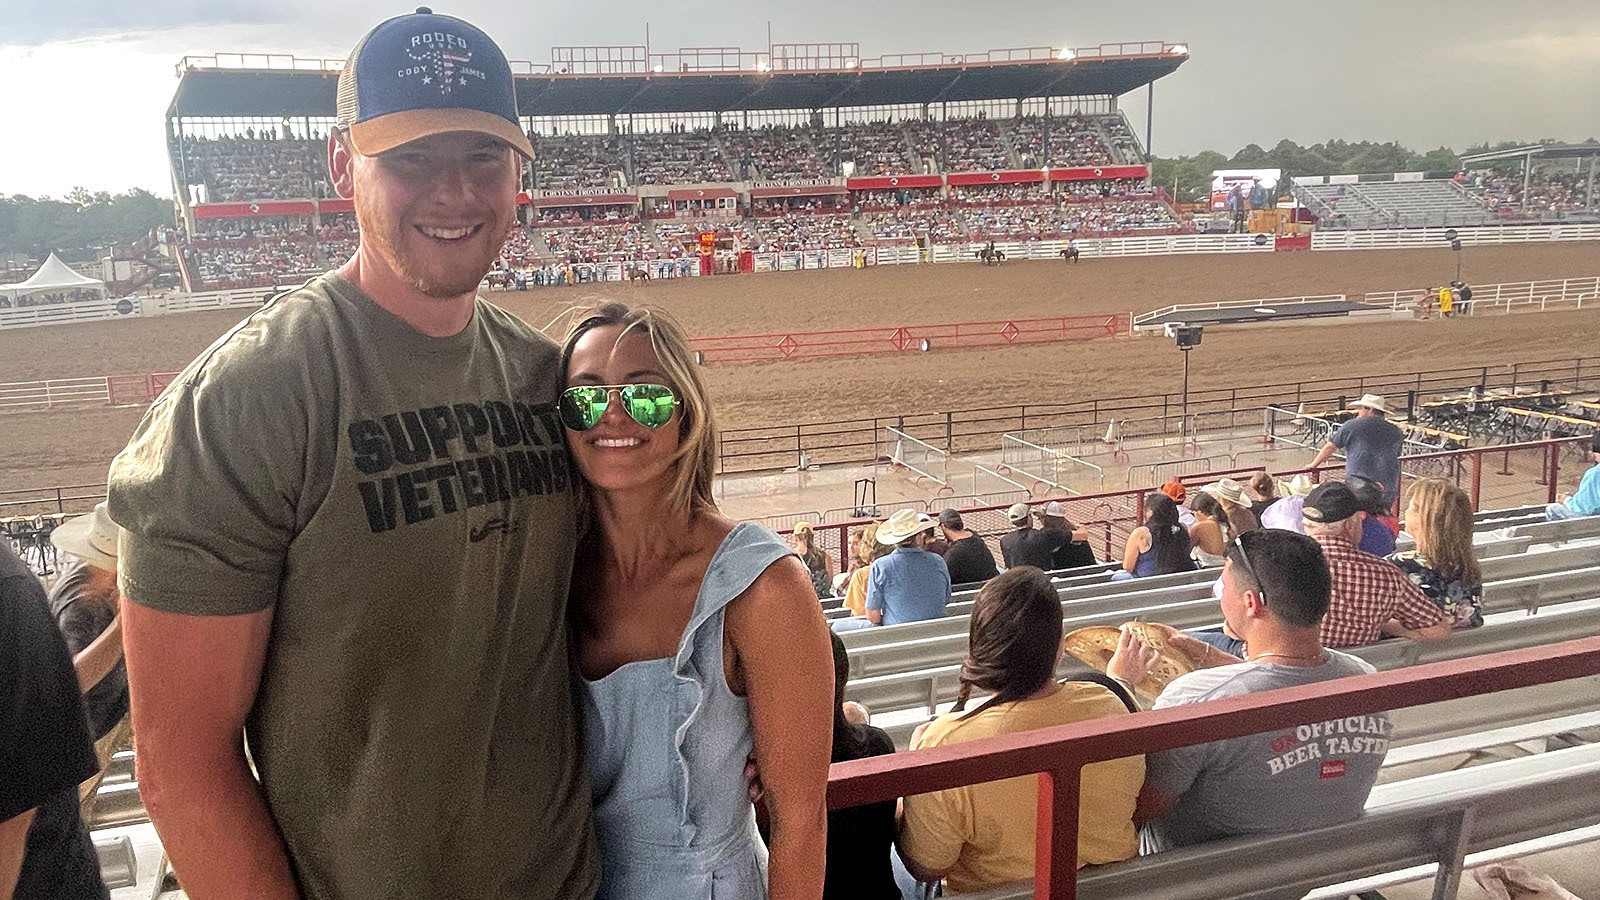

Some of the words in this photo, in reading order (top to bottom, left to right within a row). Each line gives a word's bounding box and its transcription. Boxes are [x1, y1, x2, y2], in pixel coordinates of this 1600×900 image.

[411, 32, 466, 48] RODEO
[398, 66, 427, 78] CODY
[460, 67, 485, 80] JAMES
[348, 401, 563, 474] SUPPORT
[358, 450, 568, 533] VETERANS
[1267, 743, 1320, 775] BEER
